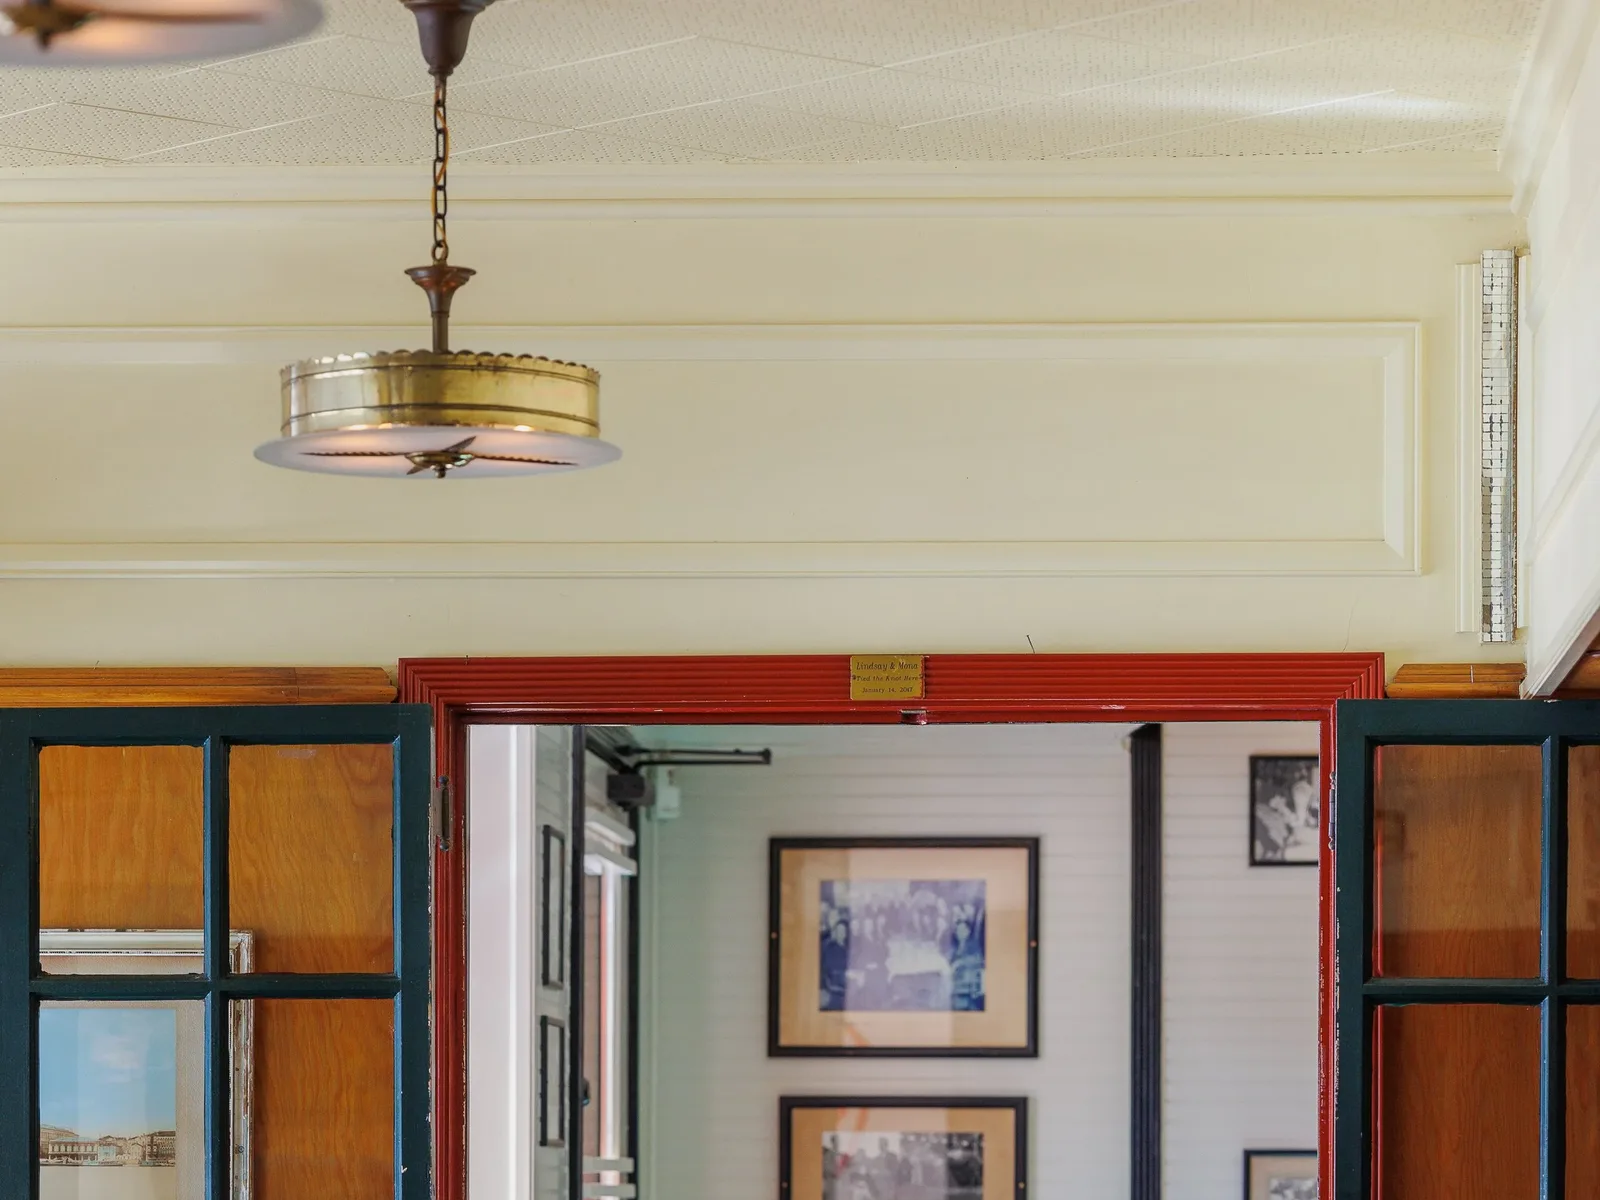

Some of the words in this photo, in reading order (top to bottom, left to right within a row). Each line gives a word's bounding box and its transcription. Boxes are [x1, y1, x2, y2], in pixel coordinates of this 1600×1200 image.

[856, 662, 888, 671] Lindsay
[889, 662, 896, 670] &
[898, 662, 918, 670] Mona
